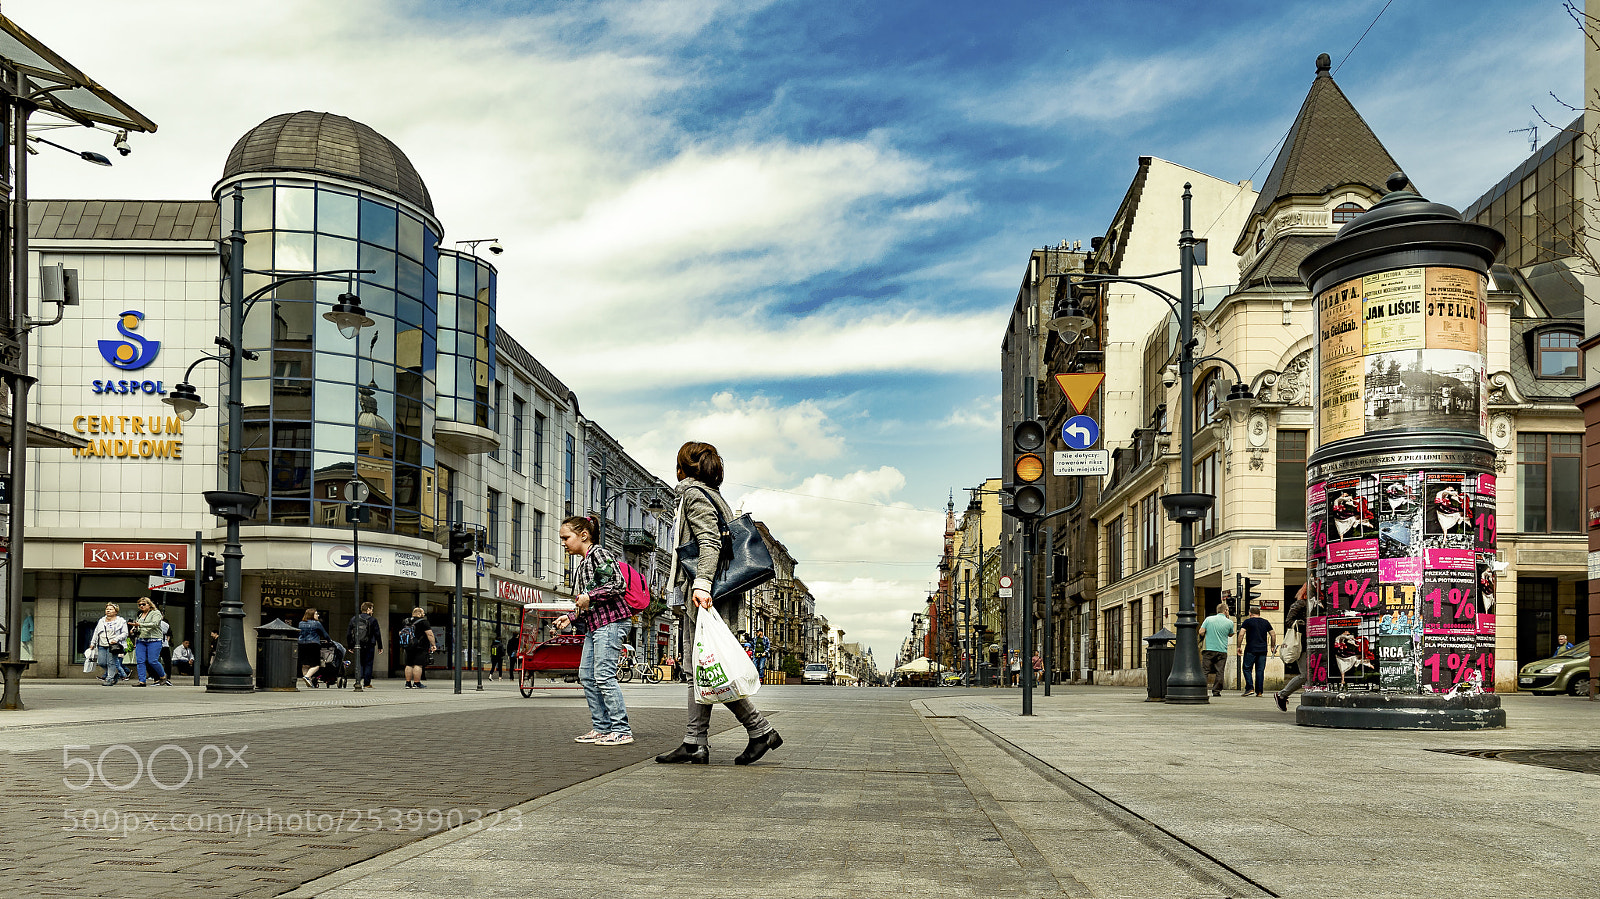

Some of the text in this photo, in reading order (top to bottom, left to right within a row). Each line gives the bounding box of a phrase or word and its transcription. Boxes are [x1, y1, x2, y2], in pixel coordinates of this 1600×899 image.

[1366, 304, 1385, 320] JAK
[1388, 299, 1421, 317] LIŚCIE
[92, 379, 167, 395] SASPOL
[72, 415, 182, 435] CENTRUM
[91, 549, 179, 563] KAMELEON
[1327, 577, 1379, 609] 1%
[1425, 588, 1475, 619] 1%
[1424, 653, 1475, 684] 1%
